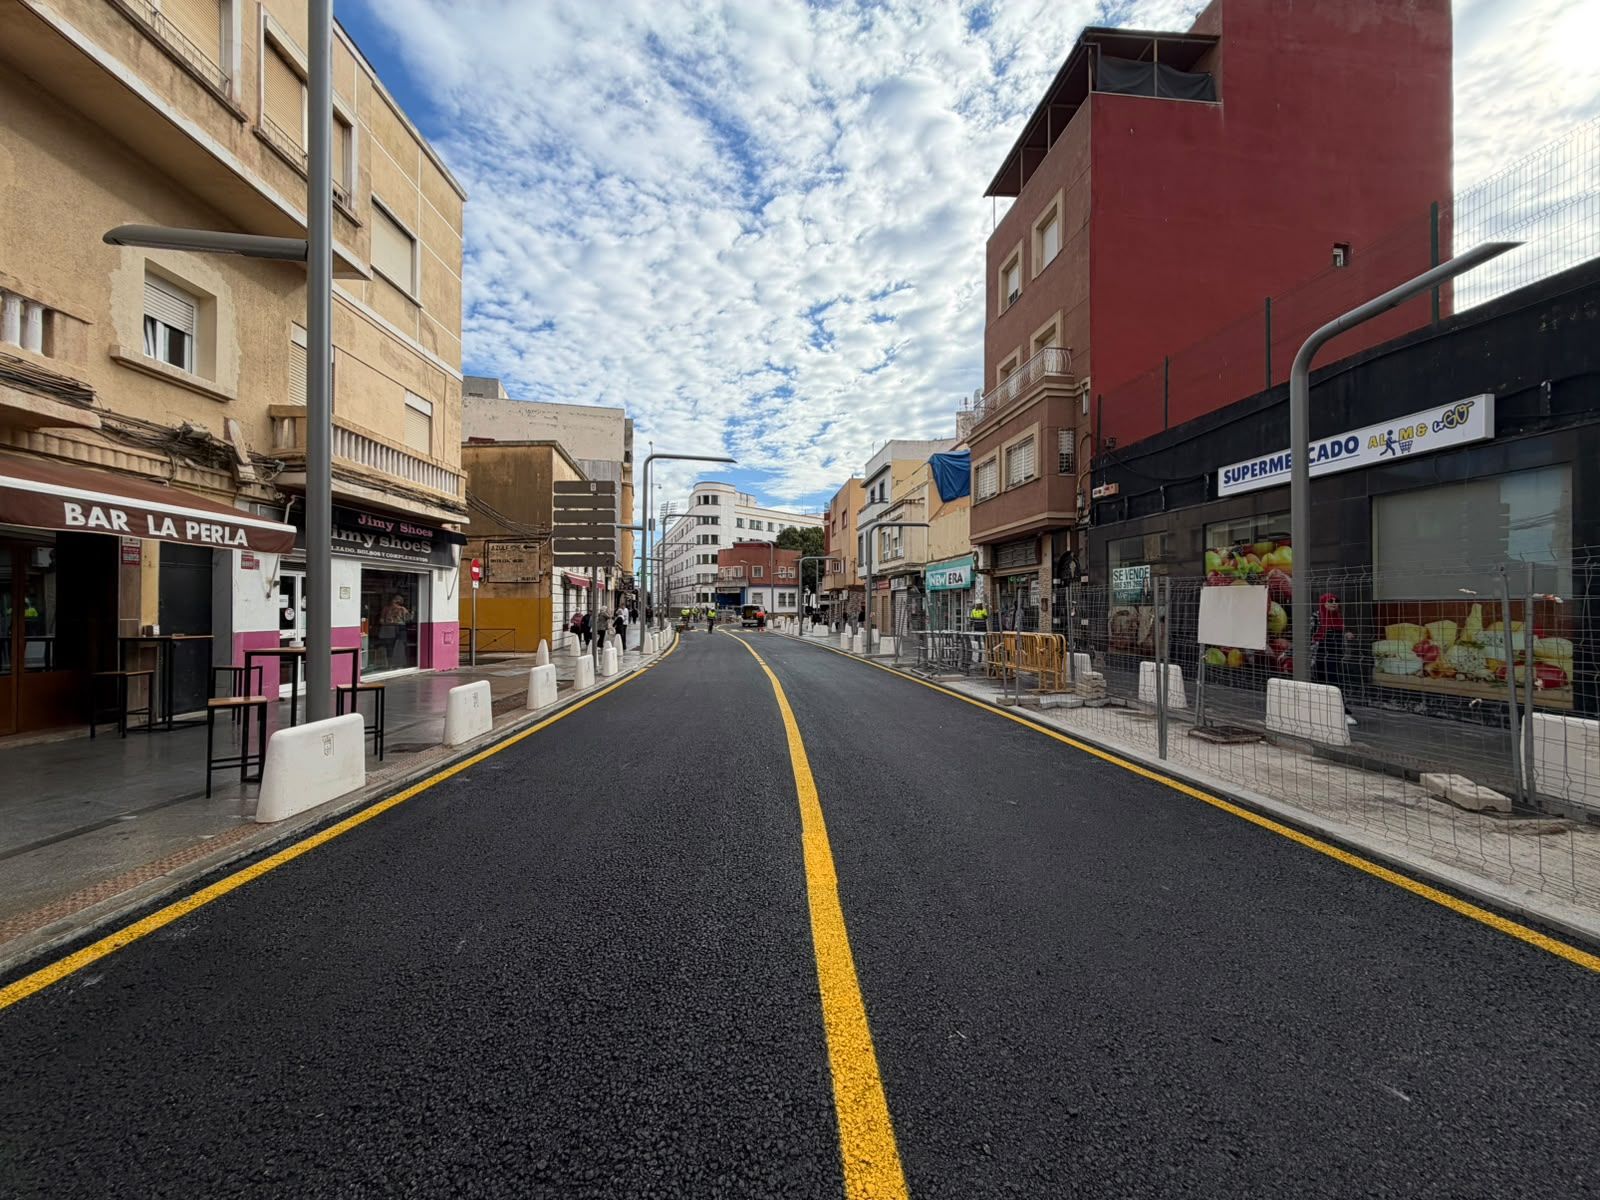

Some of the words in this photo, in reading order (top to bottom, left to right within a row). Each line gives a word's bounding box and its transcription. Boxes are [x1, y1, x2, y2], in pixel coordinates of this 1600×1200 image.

[1223, 436, 1360, 485] SUPERMECADO
[1415, 423, 1429, 438] &
[63, 501, 132, 533] BAR
[147, 514, 179, 539] LA
[185, 520, 249, 547] PERLA
[331, 524, 376, 548] imy
[358, 514, 394, 533] Jimy
[400, 522, 433, 538] Shoes
[930, 573, 946, 586] NEW
[948, 572, 963, 585] ERA
[1113, 569, 1123, 582] SE
[1125, 566, 1149, 581] VENDE
